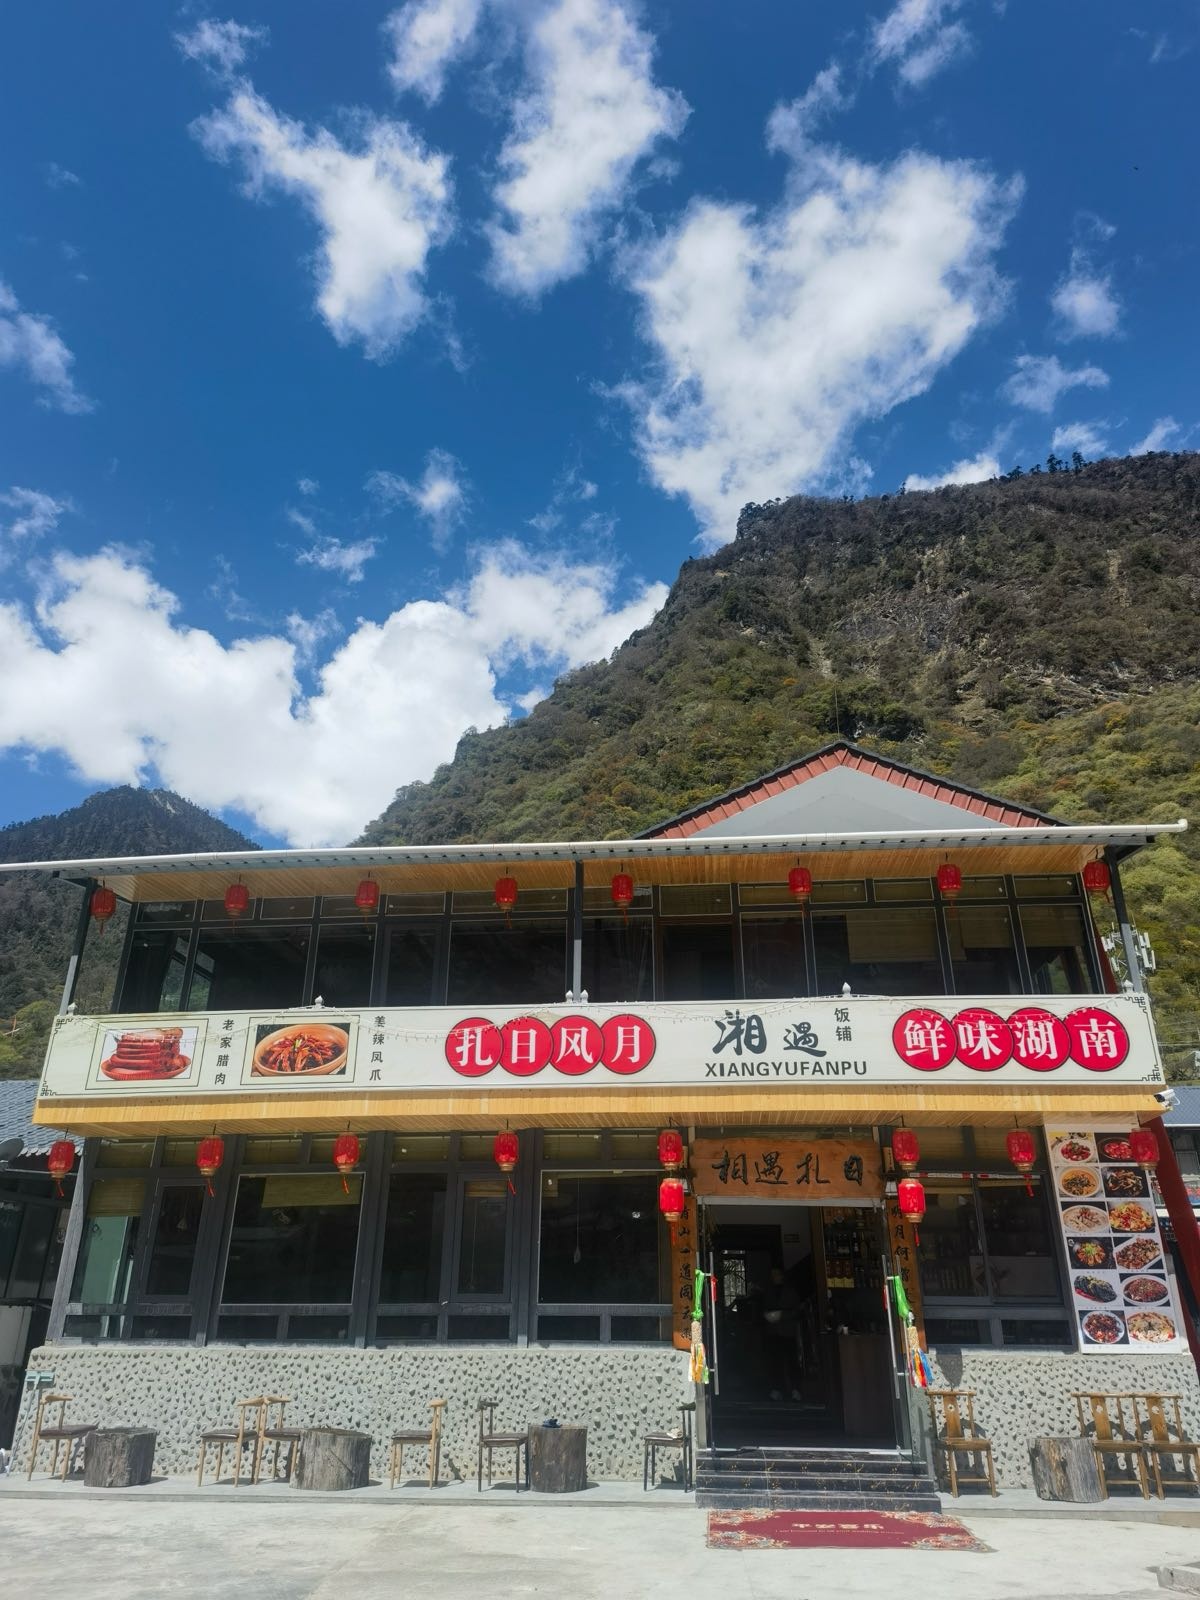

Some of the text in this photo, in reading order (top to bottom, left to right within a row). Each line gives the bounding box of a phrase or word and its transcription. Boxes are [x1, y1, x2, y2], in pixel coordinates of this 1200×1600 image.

[455, 1024, 641, 1067] 扎日风月
[712, 1008, 827, 1058] 湘遇
[834, 1007, 852, 1042] 饭铺
[903, 1018, 1118, 1061] 鲜味湖南
[213, 1018, 233, 1086] 老家腊肉
[368, 1015, 386, 1082] 姜辣凤爪
[705, 1061, 867, 1077] XIANGYUFANPU
